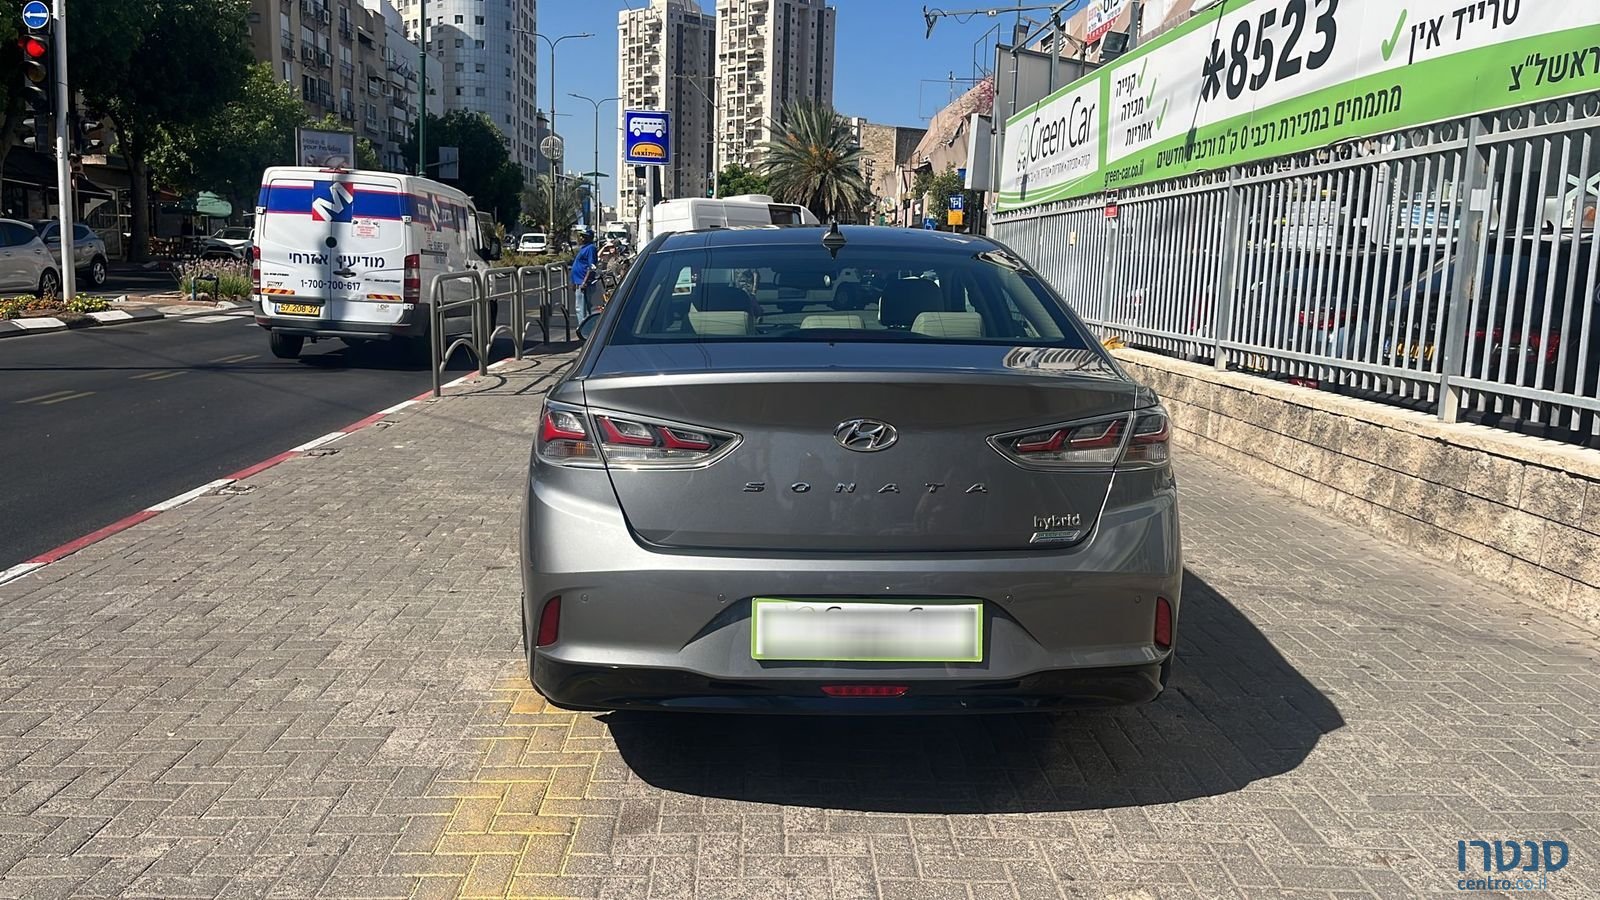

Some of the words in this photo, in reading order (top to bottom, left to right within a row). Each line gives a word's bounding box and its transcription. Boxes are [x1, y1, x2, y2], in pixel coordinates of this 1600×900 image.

[1452, 0, 1521, 41] טרייד
[1408, 14, 1445, 65] אין
[1116, 72, 1137, 98] קנייה
[1120, 96, 1144, 122] מכירה
[1333, 84, 1402, 127] מתמחים
[1030, 116, 1066, 163] Green
[1068, 95, 1096, 148] Car
[1125, 119, 1154, 147] אחריות
[1250, 121, 1276, 148] רכבי
[1277, 105, 1330, 142] במכירת
[1240, 125, 1249, 150] 0
[1156, 145, 1184, 169] חדשים
[1104, 158, 1145, 187] green-car.co.il
[288, 252, 329, 266] אזרחי
[338, 255, 386, 269] מודיעין
[300, 279, 361, 291] 1-700-700-617
[743, 481, 988, 494] SONATA
[1033, 513, 1081, 530] hybrid
